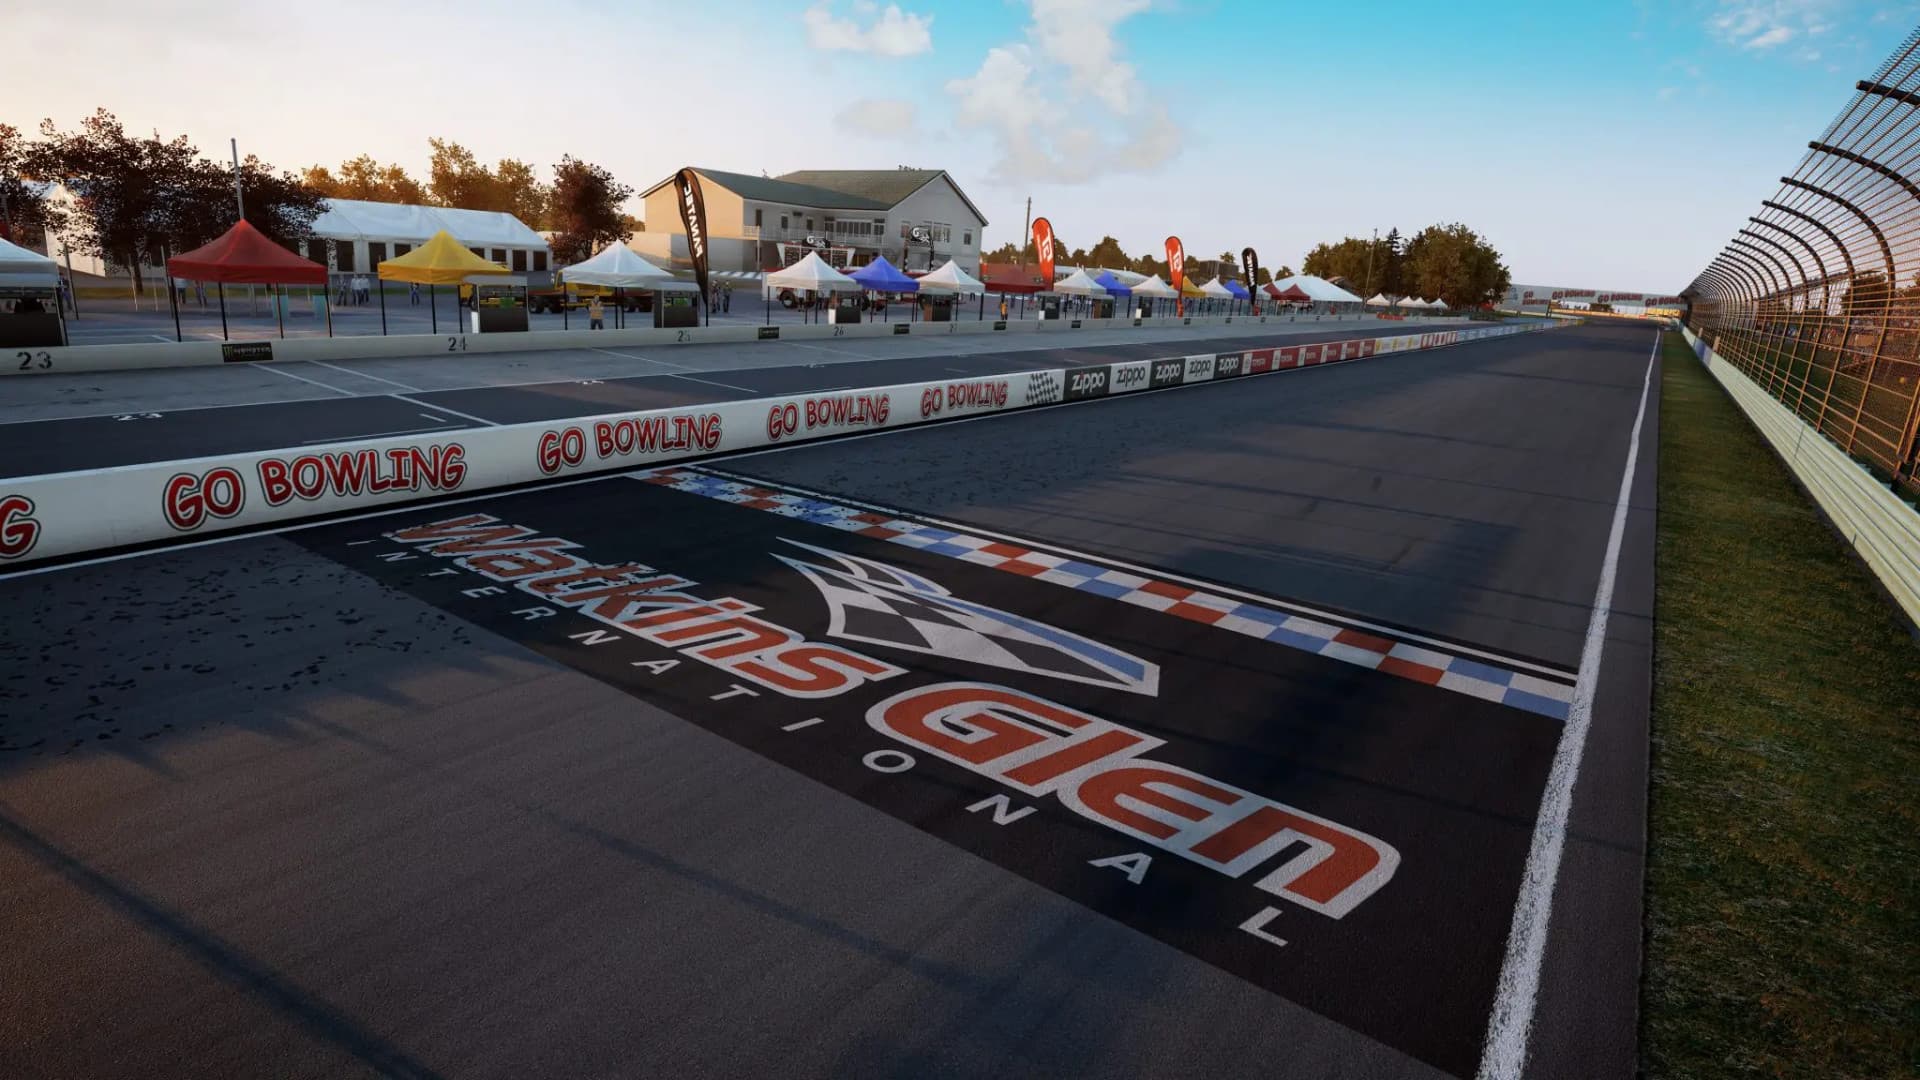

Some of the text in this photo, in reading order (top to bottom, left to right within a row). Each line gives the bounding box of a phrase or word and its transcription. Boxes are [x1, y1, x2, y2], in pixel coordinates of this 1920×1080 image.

[16, 351, 53, 370] 23
[1156, 362, 1181, 383] zippo
[1189, 359, 1211, 377] zippo
[1218, 356, 1239, 374] zippo
[1071, 371, 1105, 395] zippo
[1117, 365, 1146, 387] zippo
[920, 380, 1009, 419] GO BOWLING
[766, 393, 891, 441] GO BOWLING
[537, 413, 723, 475] GO BOWLING
[162, 442, 468, 531] GO BOWLING
[381, 513, 1402, 922] Watkins Glen
